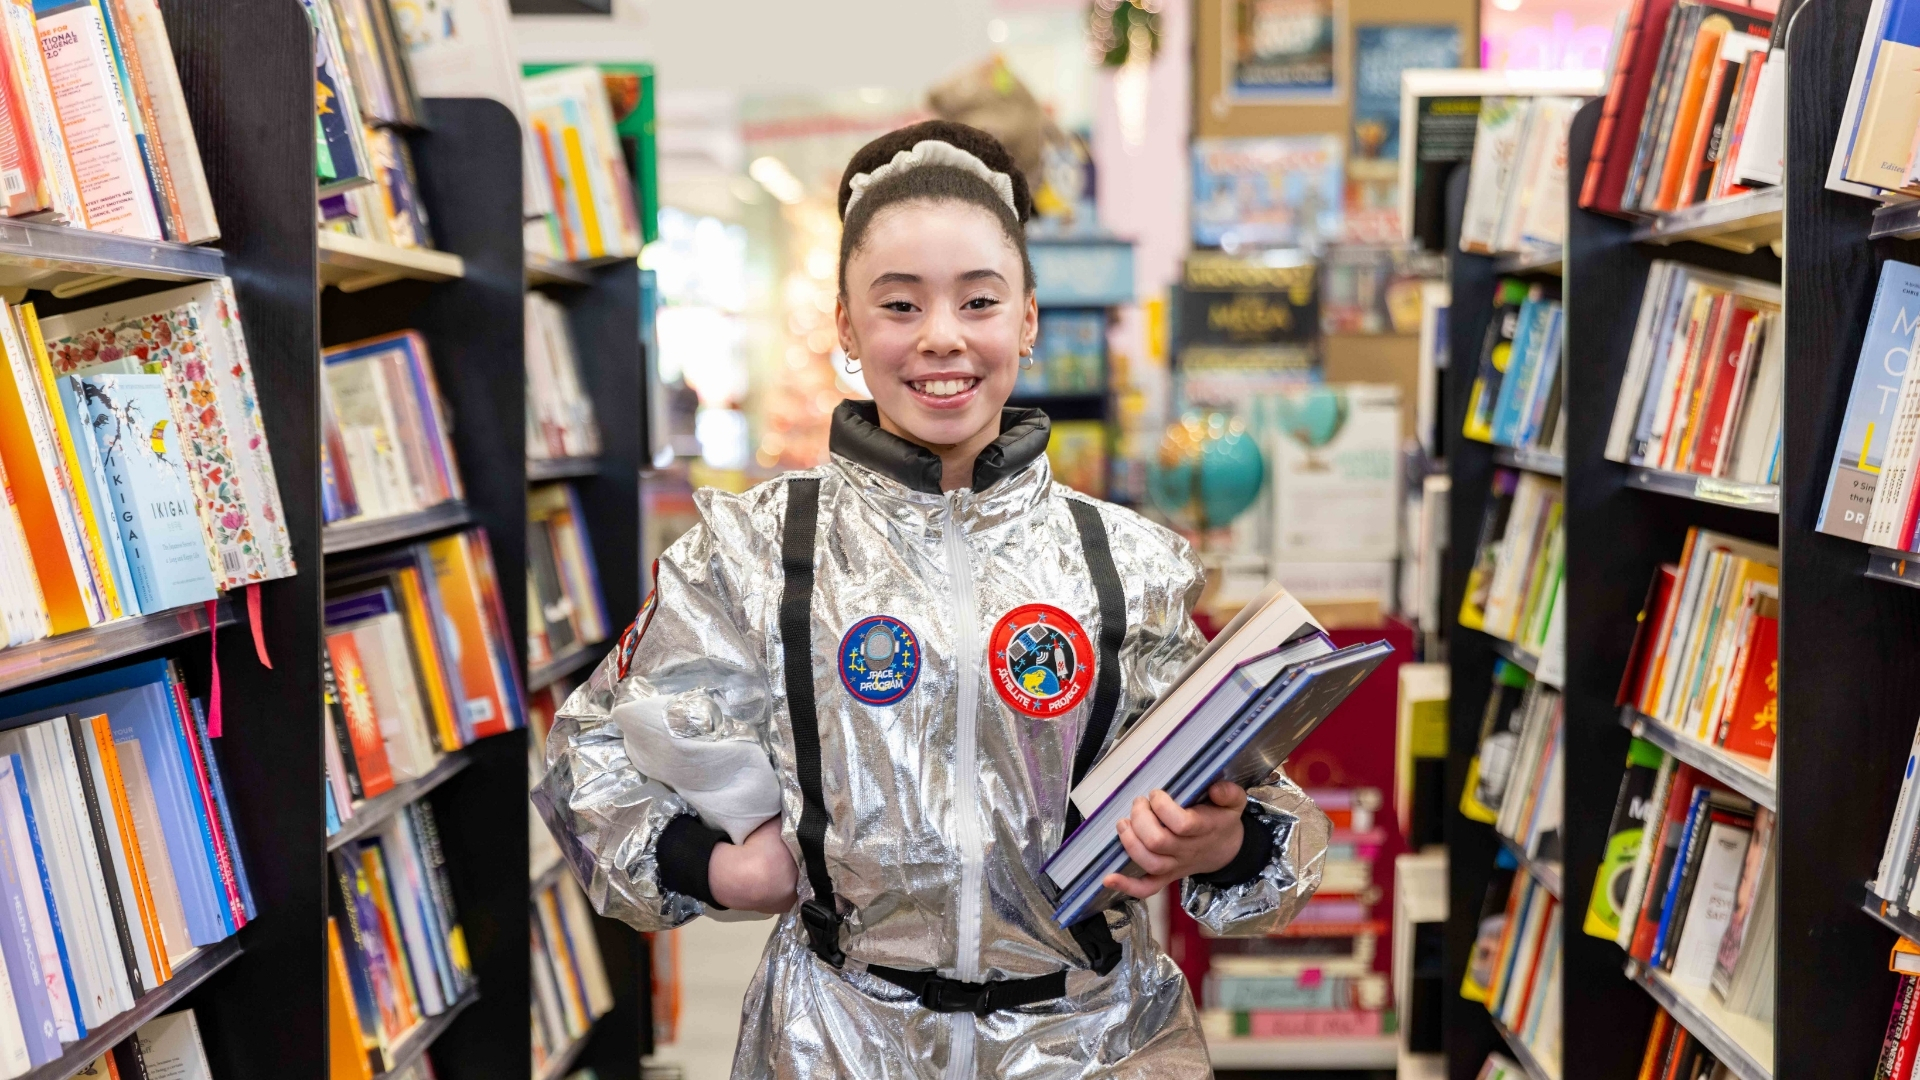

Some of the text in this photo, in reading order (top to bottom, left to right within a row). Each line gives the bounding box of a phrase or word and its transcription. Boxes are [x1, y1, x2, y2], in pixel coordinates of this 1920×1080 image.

[53, 25, 68, 33] FOR
[94, 17, 124, 106] INTELLIGENCE
[147, 108, 178, 204] RHONDA BYRNE
[100, 193, 122, 203] INSIGHTS
[156, 166, 167, 197] BYRNE
[89, 197, 134, 213] ABOUT EMOTIONAL
[3, 328, 48, 460] MIND MAGIC
[1850, 494, 1864, 504] the
[1853, 481, 1876, 493] 9 Sim
[111, 457, 140, 558] IKIGAI
[151, 499, 189, 520] IKIGAI
[1844, 510, 1865, 525] DR
[62, 459, 84, 524] WAYNE
[88, 549, 107, 597] DYER
[860, 678, 905, 691] PROGRAM
[867, 669, 893, 680] SPACE
[996, 667, 1080, 712] SATELLITE PROJECT
[113, 726, 133, 736] YOUR
[99, 731, 107, 751] THE
[105, 760, 123, 818] COURAGE
[63, 728, 76, 768] GOOD
[87, 830, 101, 870] GOOD
[99, 879, 109, 908] LIFE
[107, 727, 115, 748] THE
[112, 757, 133, 814] COURAGE
[140, 864, 154, 902] HAPPY
[13, 895, 41, 987] HELEN JACOBS
[1887, 1008, 1901, 1041] YOUR
[1894, 986, 1914, 1040] CHARACTER
[1885, 1040, 1899, 1078] ENERGY
[1892, 1046, 1905, 1080] OUT
